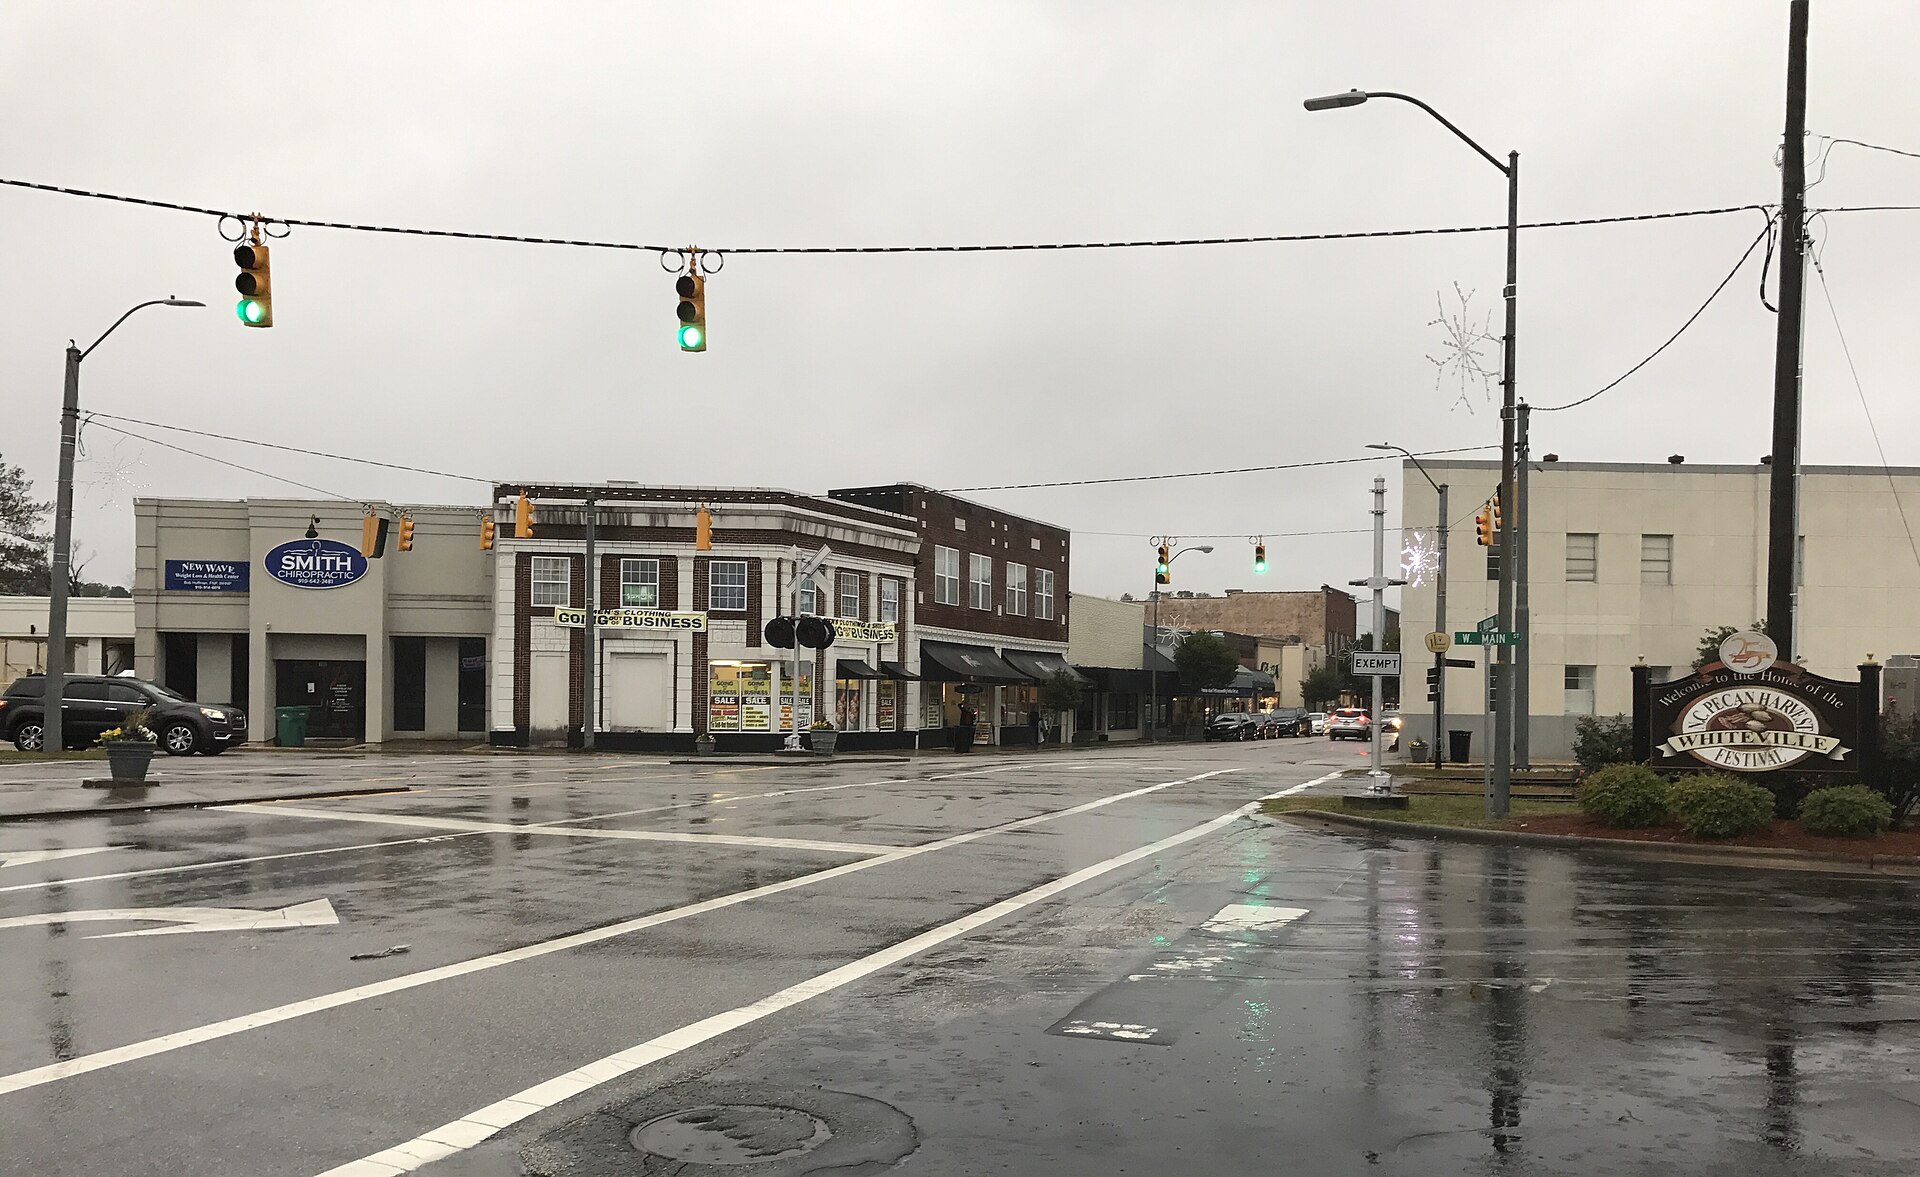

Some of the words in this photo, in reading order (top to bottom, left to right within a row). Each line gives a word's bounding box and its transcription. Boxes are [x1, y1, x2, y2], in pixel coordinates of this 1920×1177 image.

[182, 562, 204, 572] NEW
[205, 563, 235, 574] WAVE
[281, 555, 352, 571] SMITH
[277, 570, 354, 579] CHIROPRACTIC
[559, 613, 608, 625] GOIG
[623, 616, 702, 629] BUSINESS
[851, 627, 894, 639] BUSINESS
[1462, 633, 1473, 643] W.
[1481, 633, 1506, 644] MAIN
[1355, 658, 1398, 669] EXEMPT
[1715, 674, 1728, 683] to
[1805, 684, 1824, 695] of
[1822, 691, 1844, 709] the
[1703, 691, 1755, 714] PECAN
[1760, 692, 1814, 732] HARVEST
[1678, 731, 1828, 751] WHITEVILLE
[1714, 748, 1787, 767] FESTIVAL
